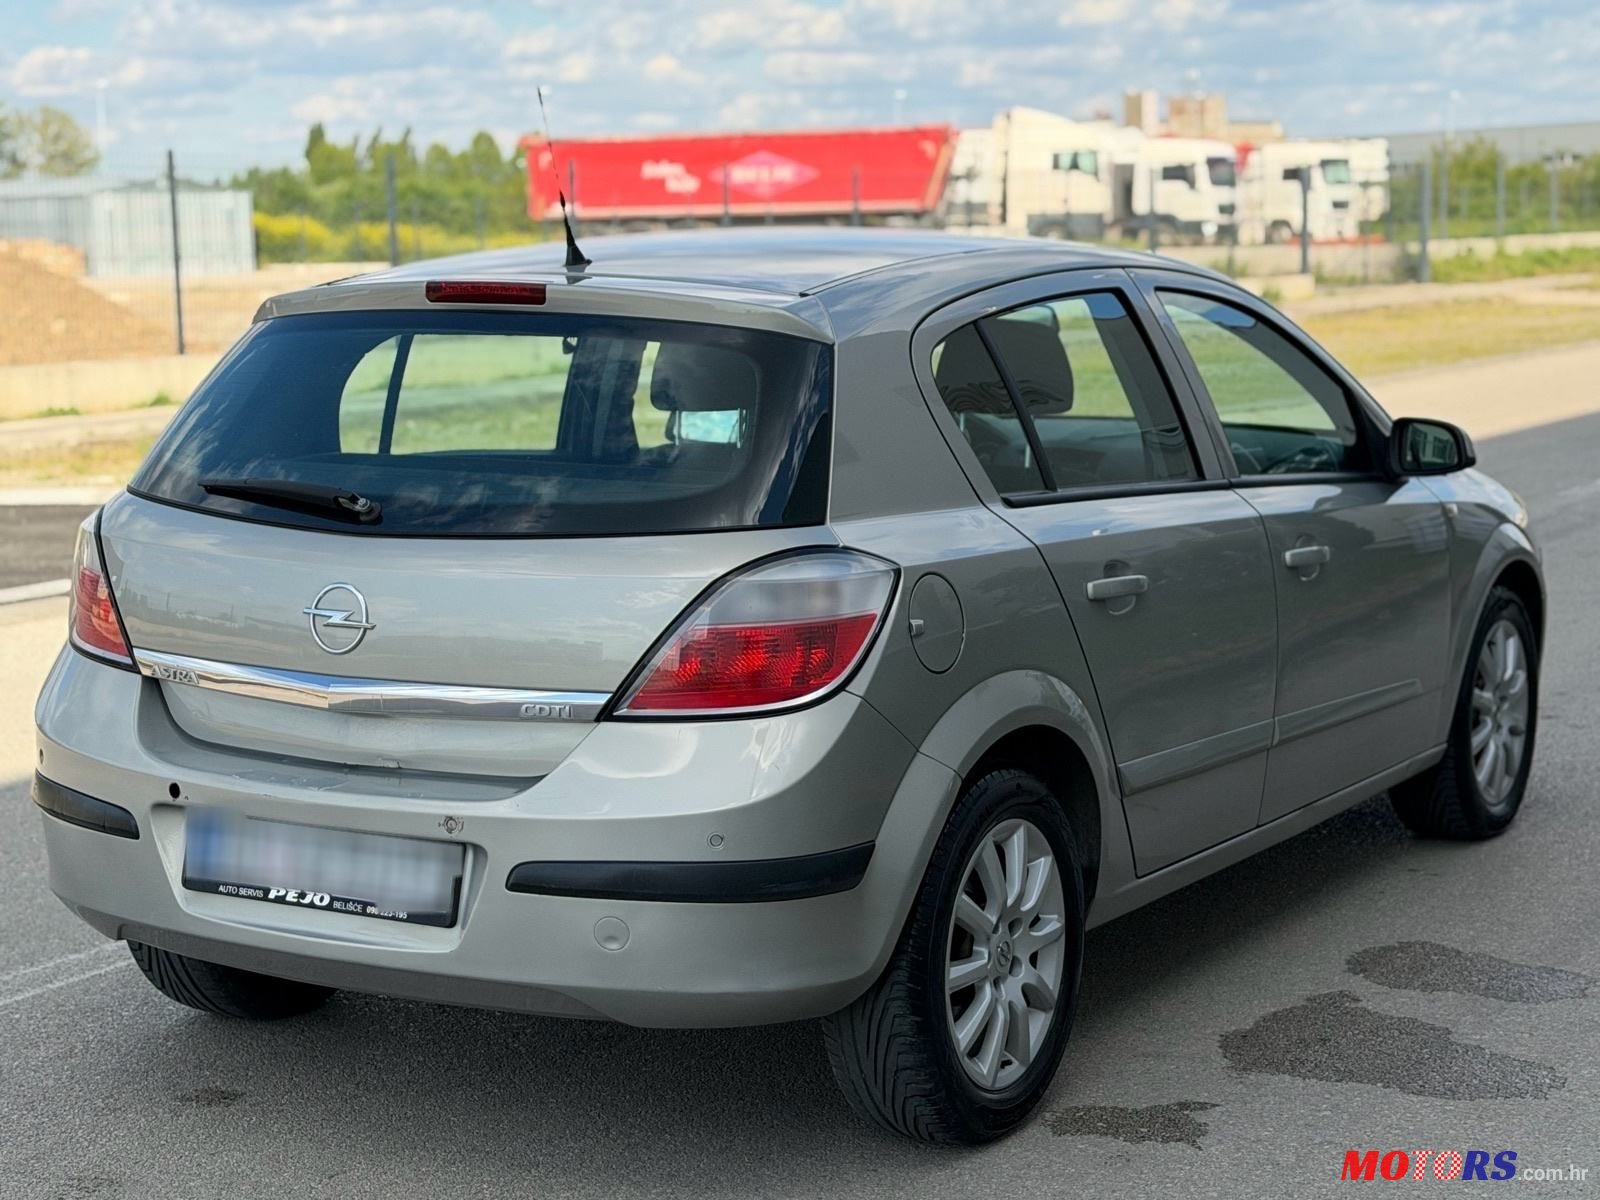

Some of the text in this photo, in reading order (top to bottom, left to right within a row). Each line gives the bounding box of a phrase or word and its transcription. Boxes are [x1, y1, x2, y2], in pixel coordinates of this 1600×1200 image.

[151, 664, 200, 685] ASTRA
[218, 885, 238, 895] AUTO
[238, 887, 264, 898] SERVIS
[267, 886, 331, 907] PEJO
[333, 900, 363, 913] BELIŠĆE
